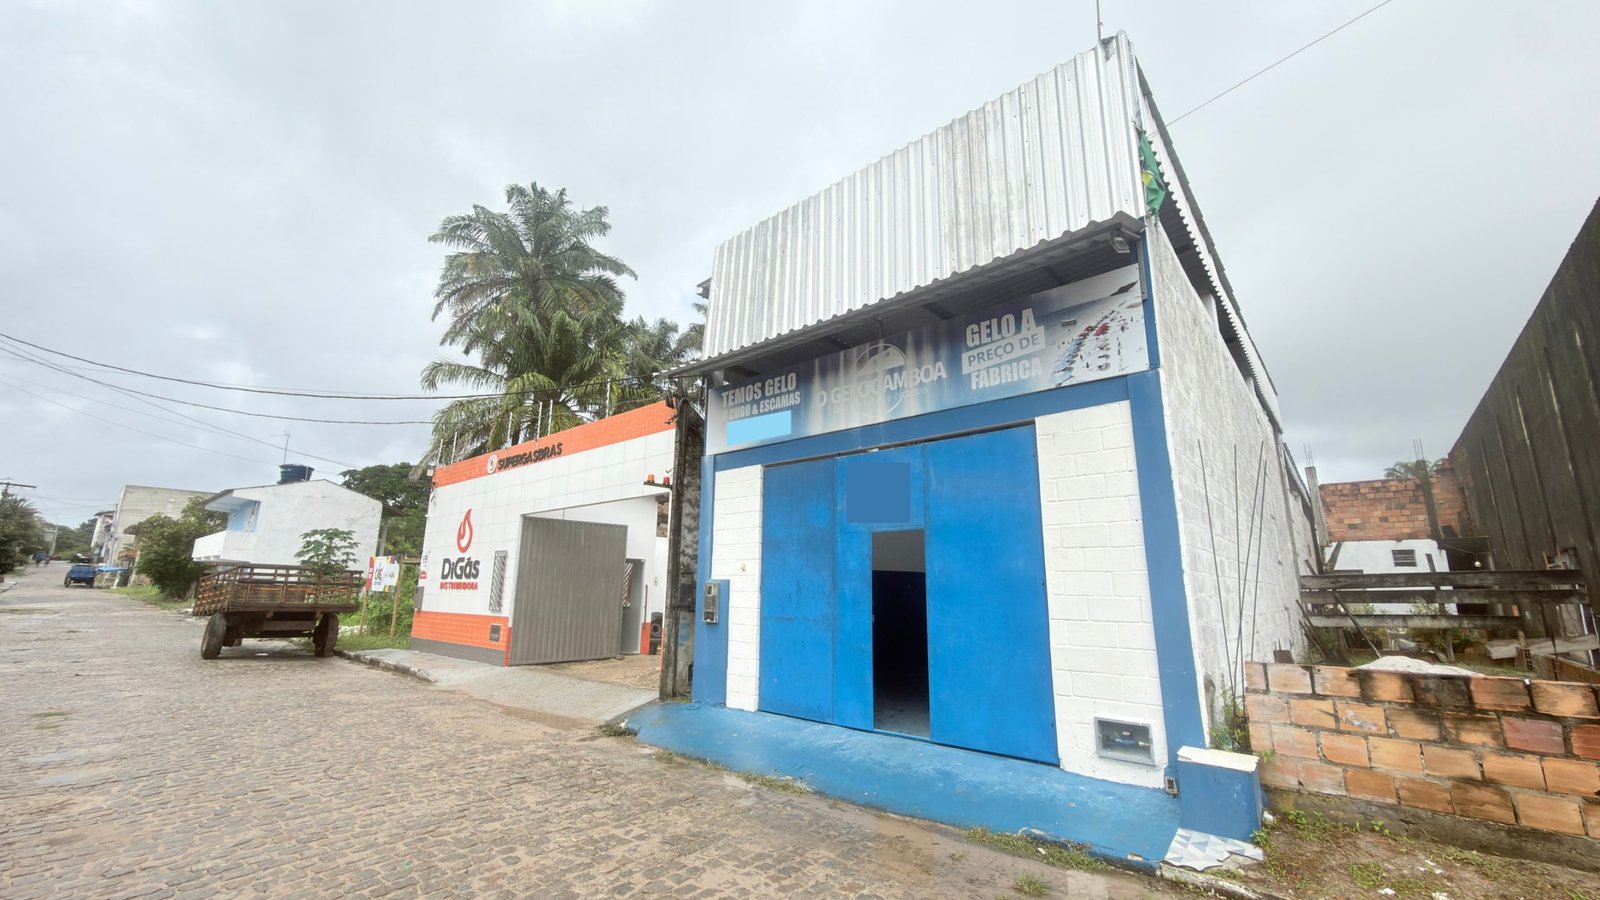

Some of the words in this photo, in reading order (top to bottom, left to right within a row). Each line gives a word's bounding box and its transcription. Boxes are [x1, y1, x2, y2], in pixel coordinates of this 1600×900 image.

[965, 314, 1016, 348] GELO
[1021, 307, 1037, 334] A
[968, 342, 1015, 367] PREÇO
[1019, 333, 1040, 350] DE
[721, 382, 762, 408] TEMOS
[765, 372, 797, 397] GELO
[816, 390, 828, 408] O
[830, 380, 869, 405] GEO
[728, 404, 751, 420] CUBO
[752, 404, 758, 415] &
[759, 391, 801, 413] ESCAMAS
[497, 442, 563, 470] SUPERGASBRAS
[440, 556, 480, 580] DiGás
[439, 581, 478, 591] DISTRIBUIDORA
